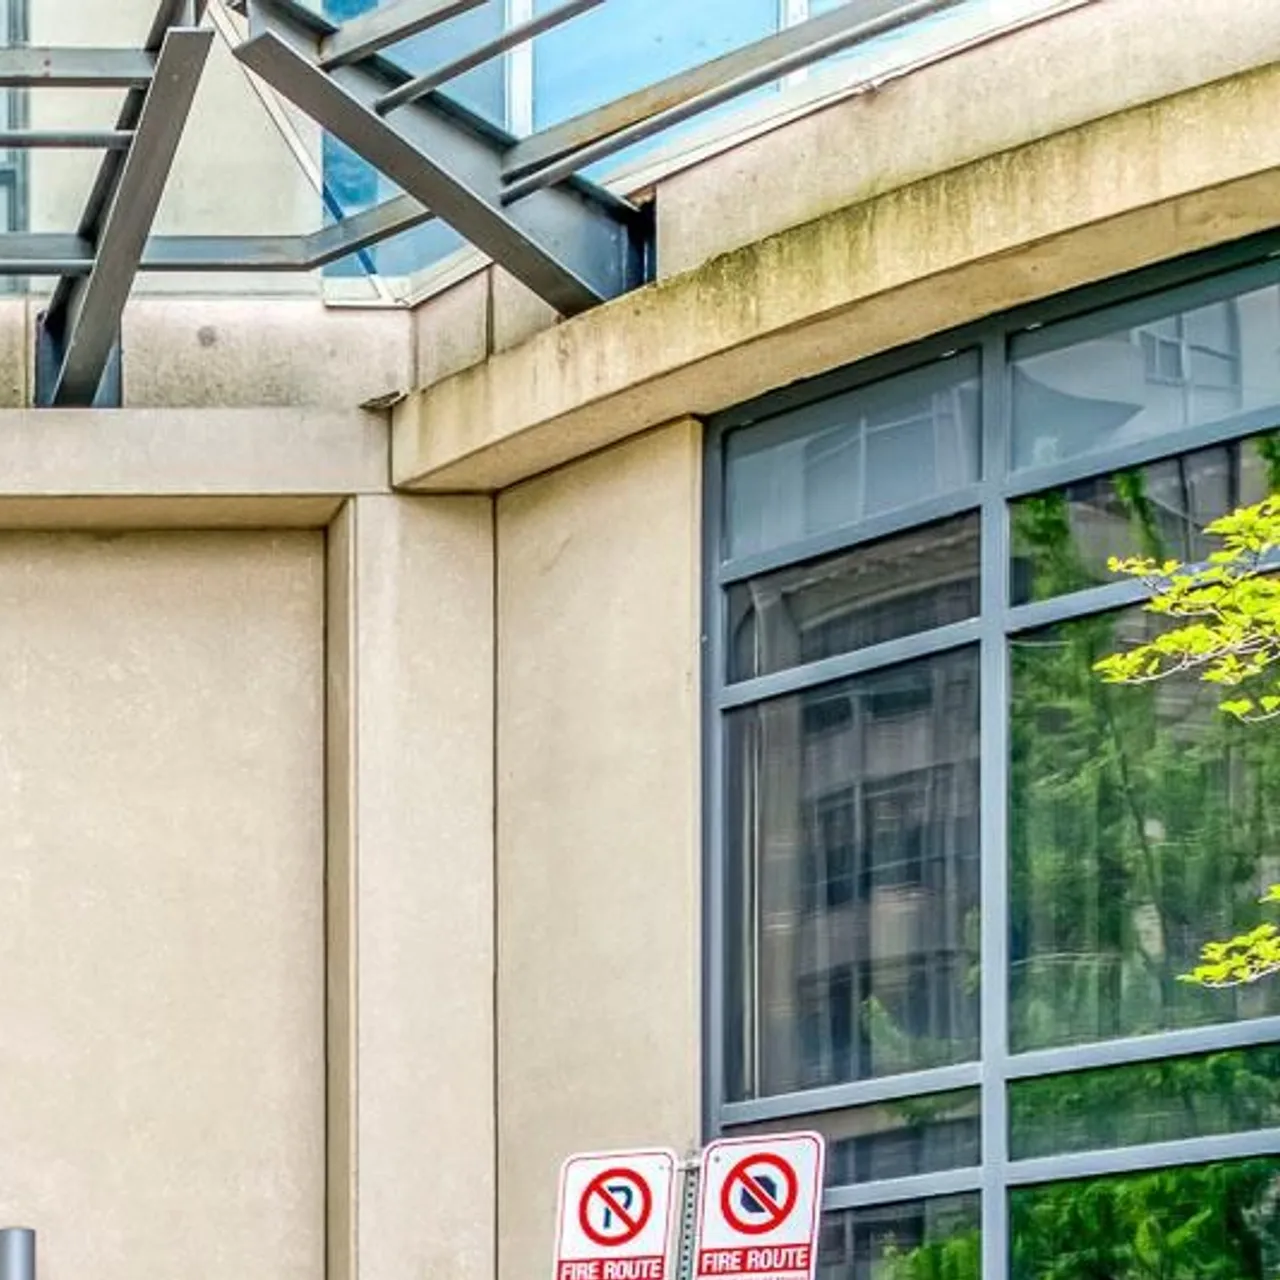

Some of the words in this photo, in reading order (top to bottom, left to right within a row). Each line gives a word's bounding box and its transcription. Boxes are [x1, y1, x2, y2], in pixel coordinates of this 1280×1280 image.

[603, 1259, 662, 1280] ROUTE
[702, 1251, 743, 1272] FIRE
[746, 1246, 808, 1270] ROUTE
